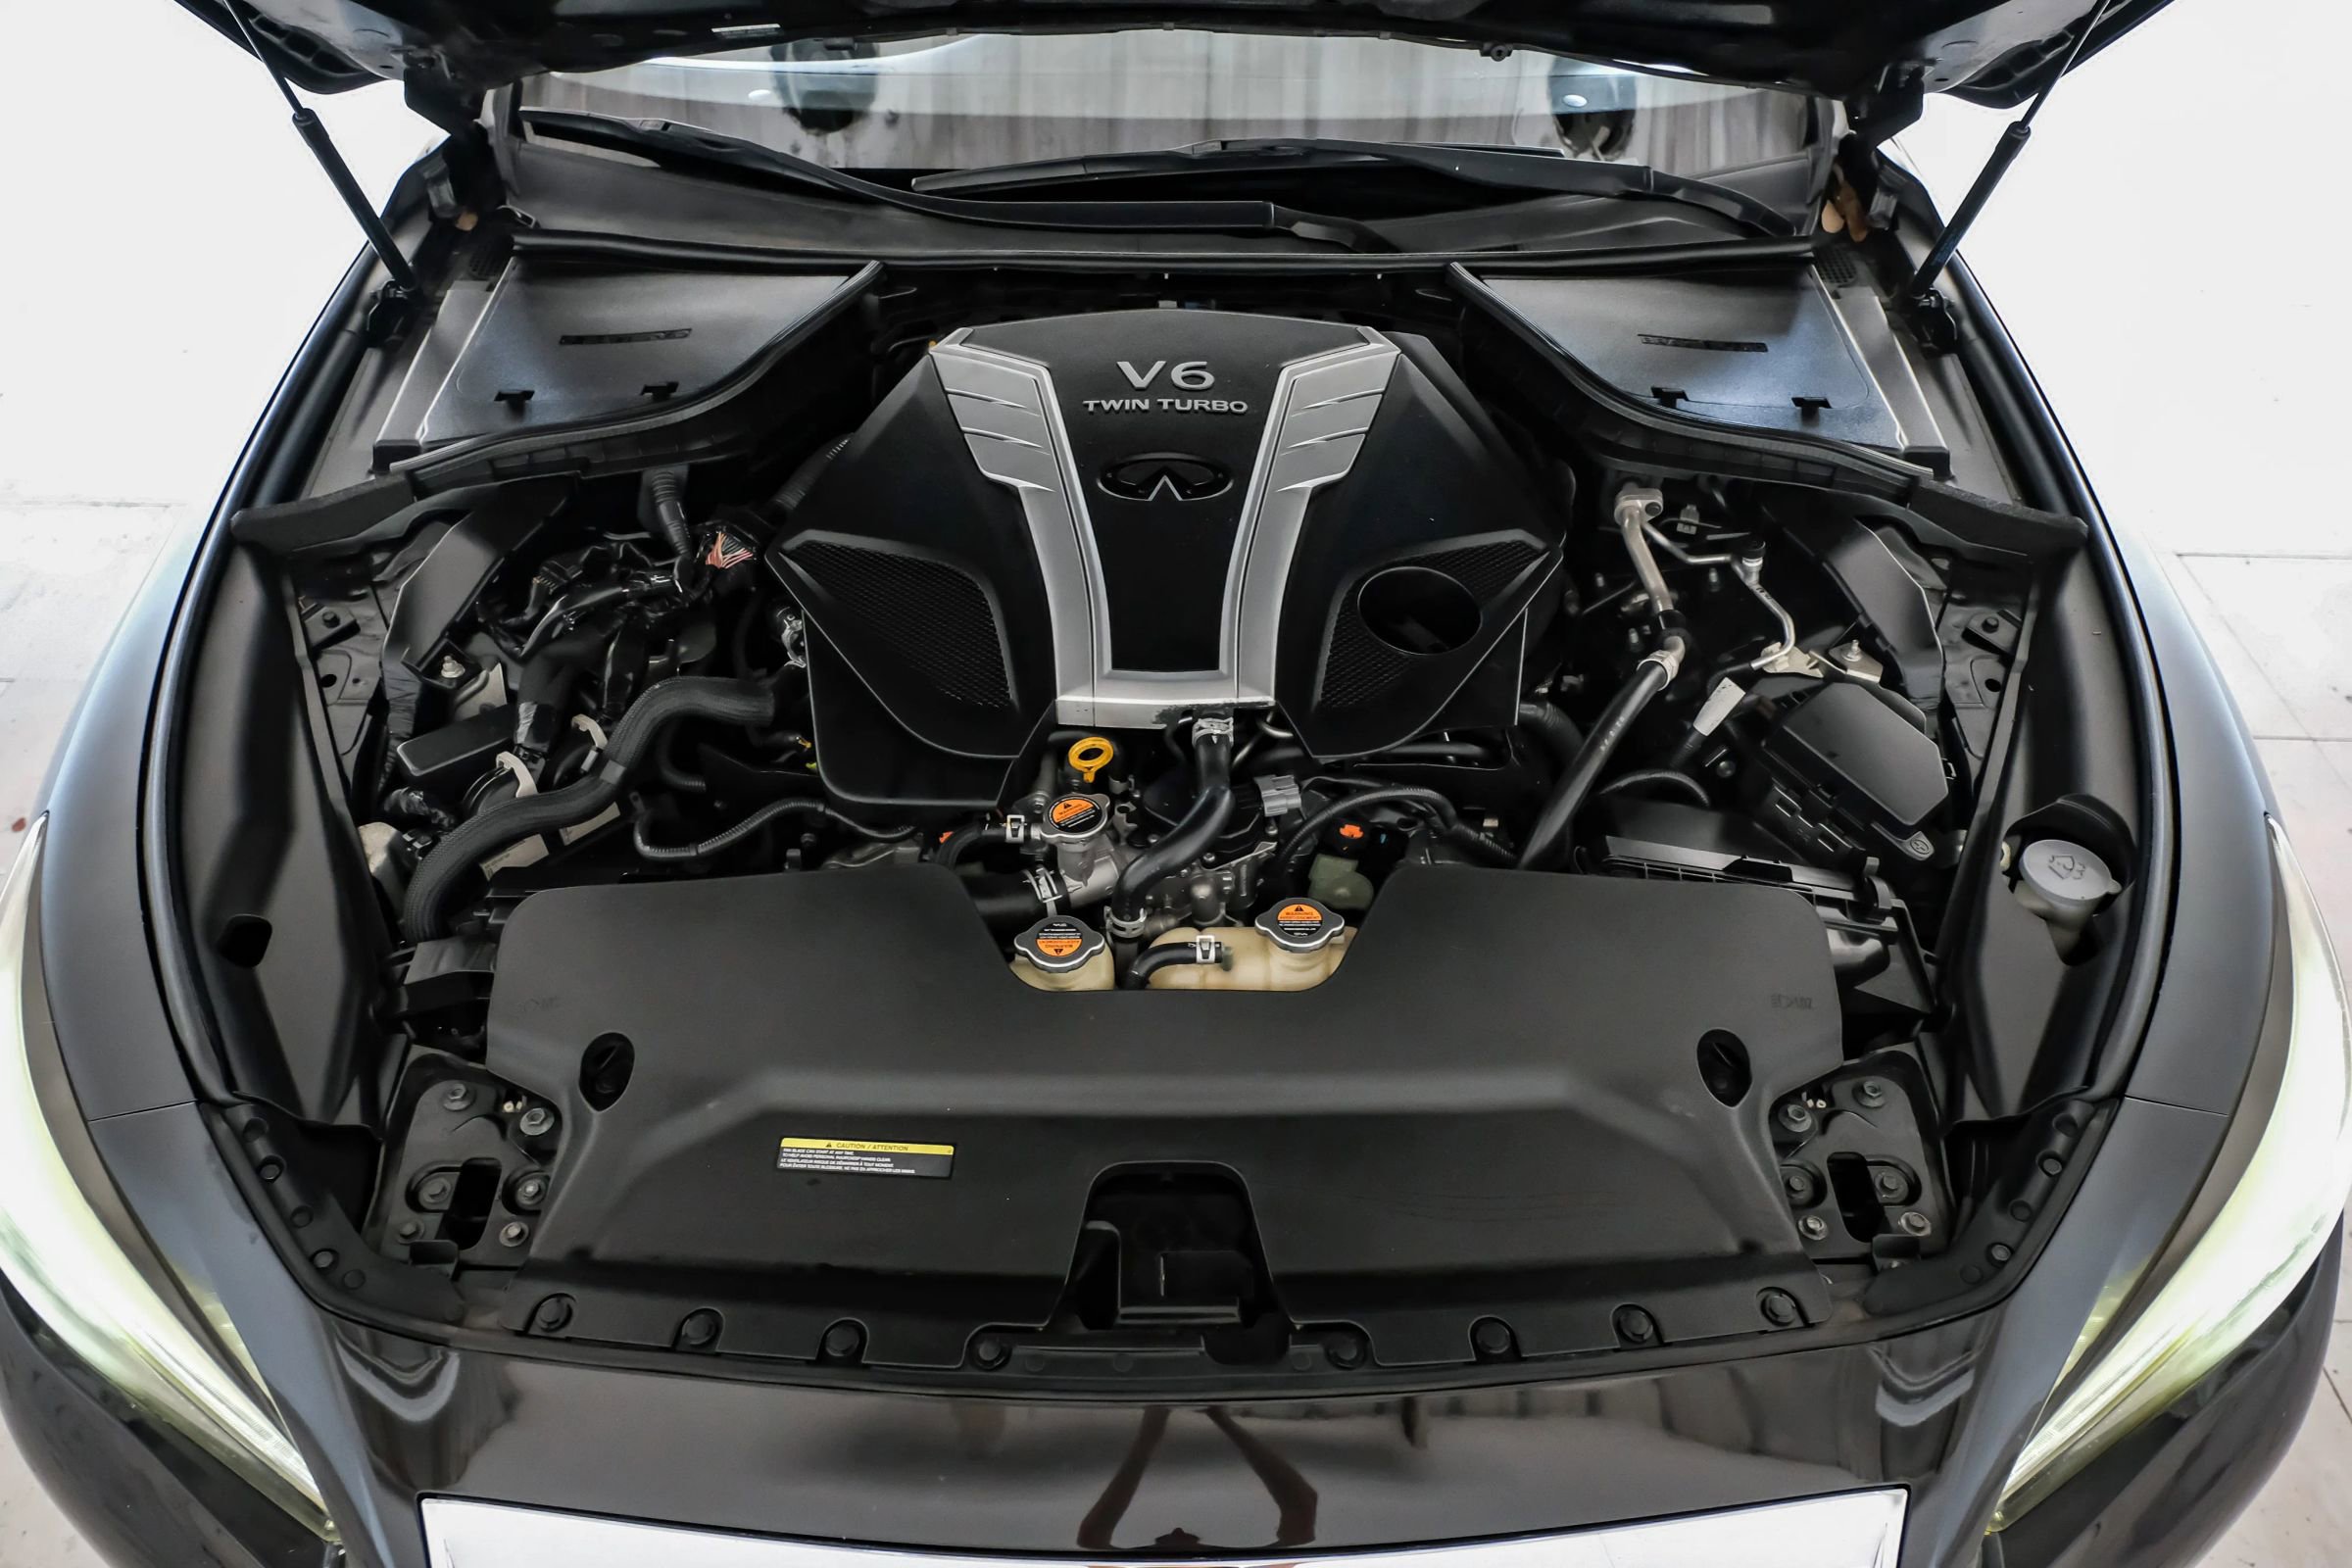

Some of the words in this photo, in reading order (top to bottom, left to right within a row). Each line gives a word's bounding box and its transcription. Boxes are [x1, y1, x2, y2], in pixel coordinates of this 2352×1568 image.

[1116, 360, 1215, 391] V6
[1082, 398, 1150, 413] TWIN
[1156, 398, 1249, 414] TURBO
